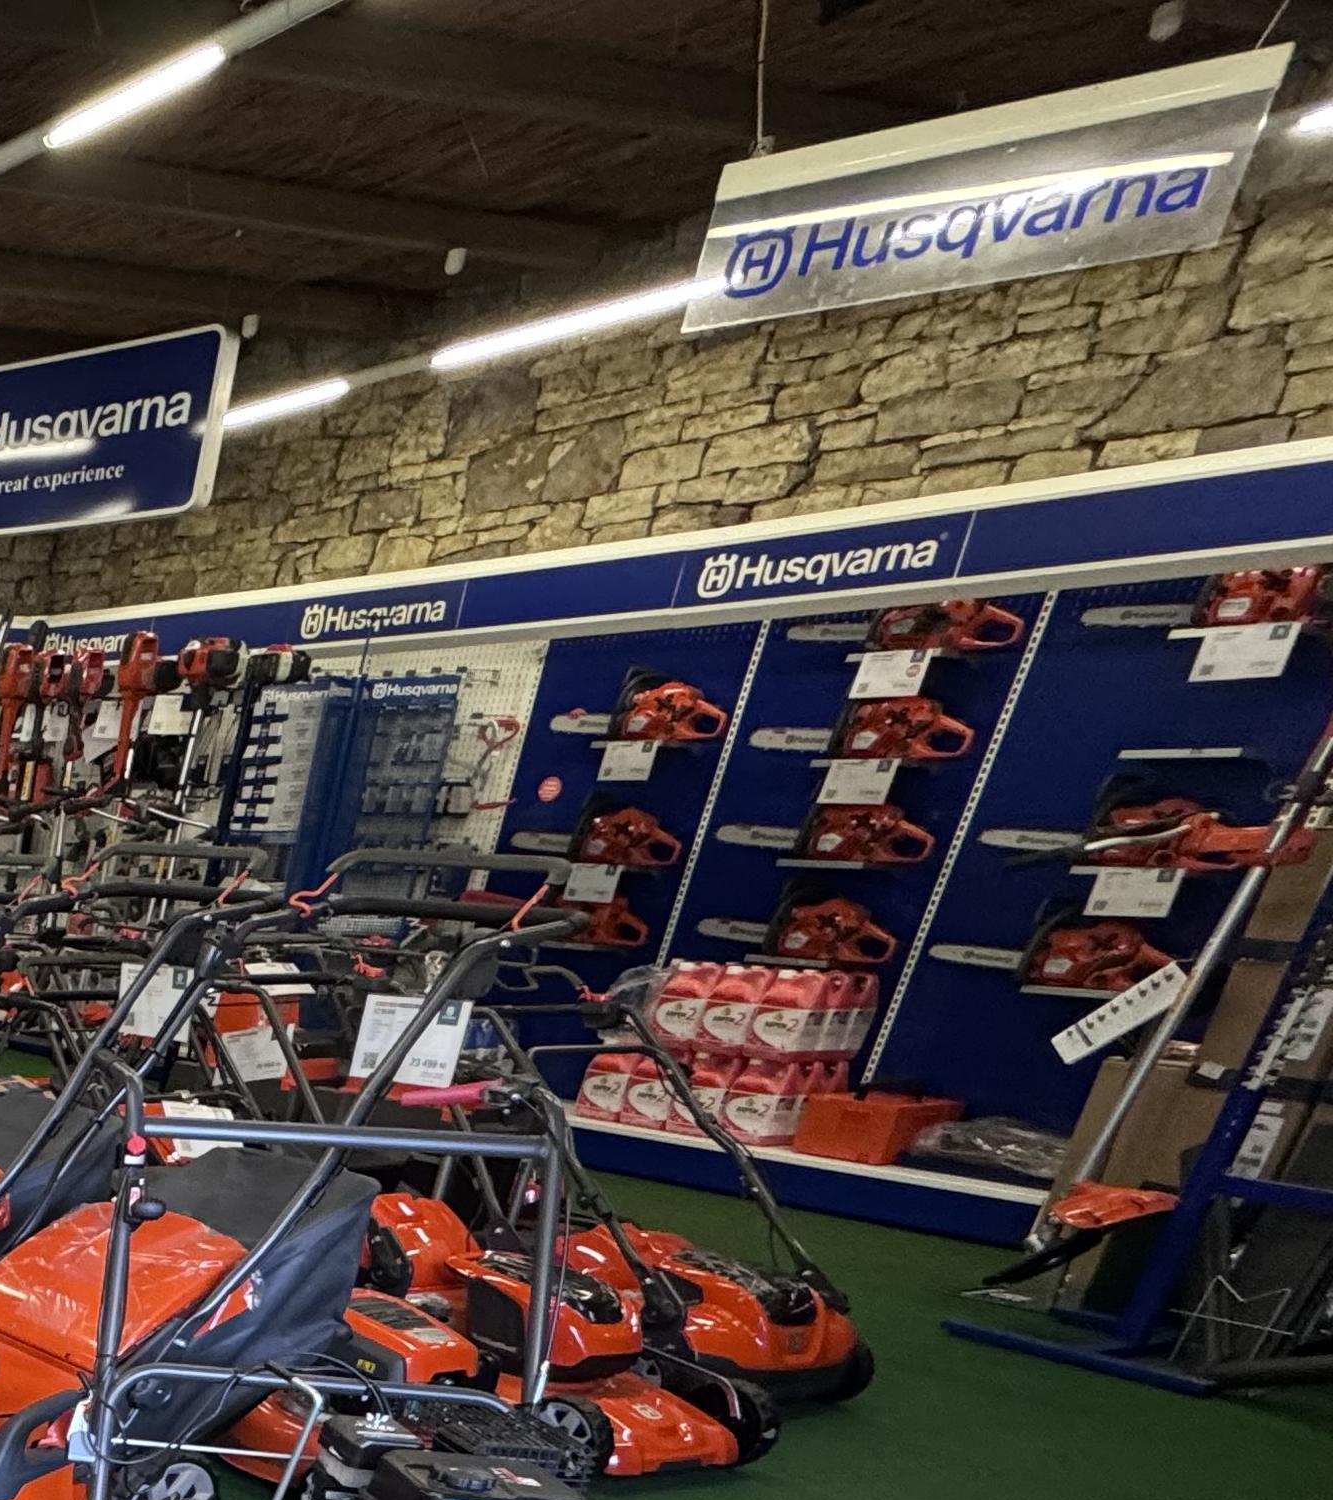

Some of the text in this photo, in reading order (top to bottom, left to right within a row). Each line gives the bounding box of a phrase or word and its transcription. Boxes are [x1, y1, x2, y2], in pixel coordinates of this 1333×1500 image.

[798, 166, 1210, 276] Husqvarna
[33, 464, 124, 491] experience
[735, 539, 939, 588] Husqvarna
[326, 600, 446, 633] Husqvarna
[387, 682, 457, 697] Husqvarna
